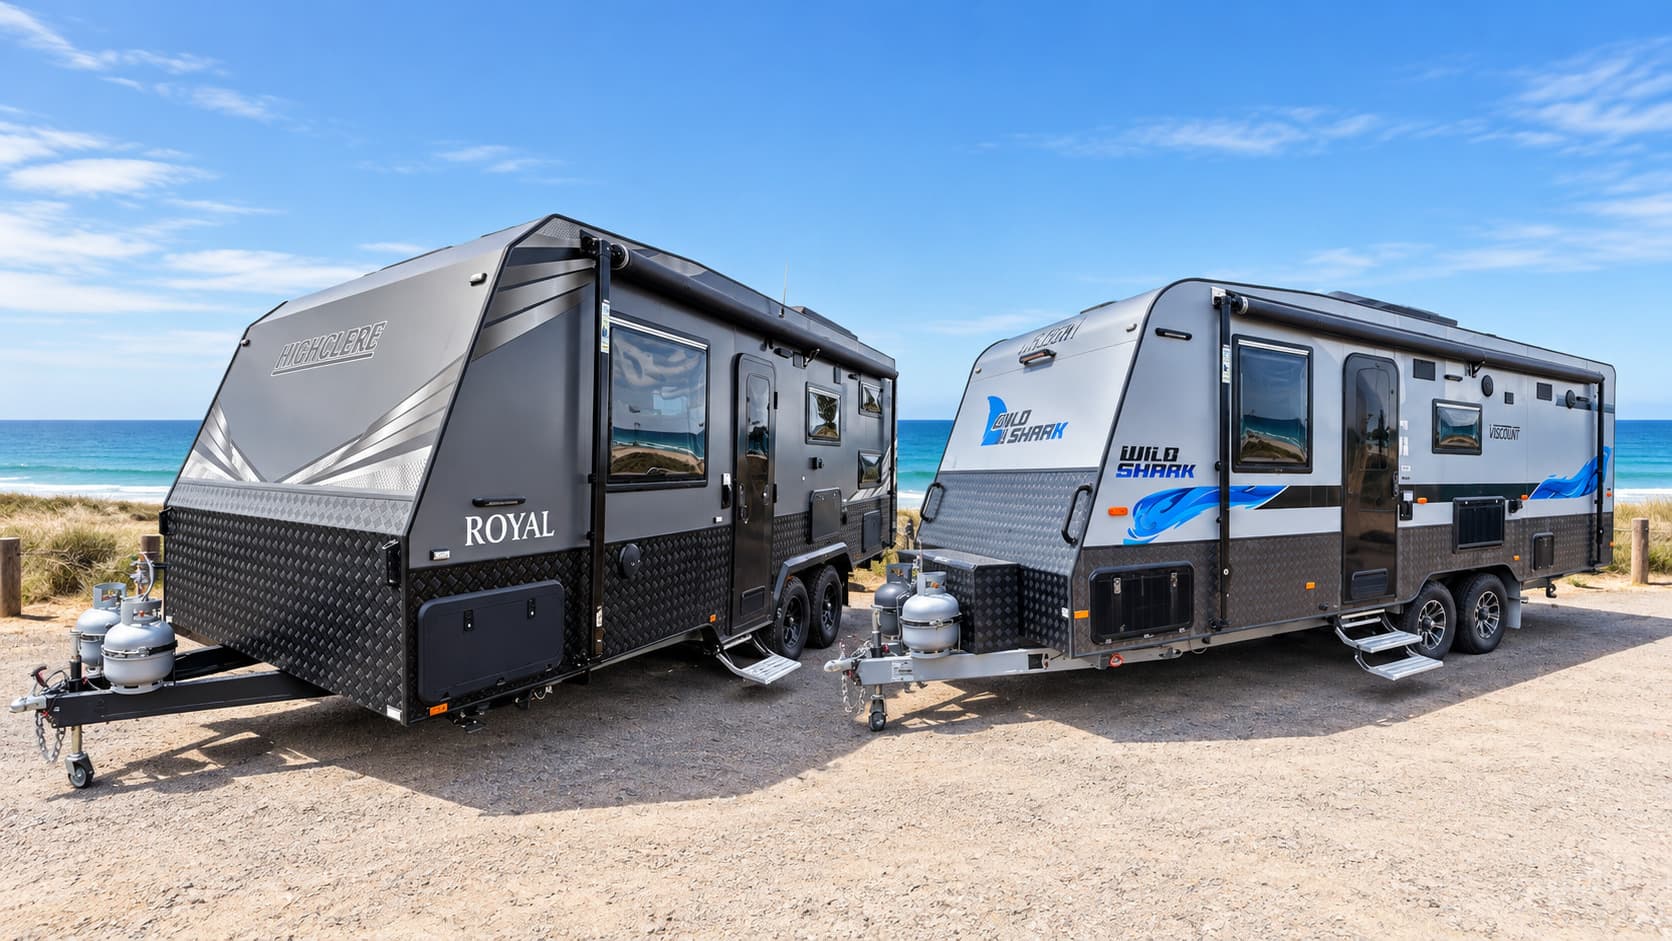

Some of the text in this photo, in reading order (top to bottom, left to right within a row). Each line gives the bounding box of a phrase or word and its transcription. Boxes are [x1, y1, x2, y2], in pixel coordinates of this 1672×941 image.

[275, 320, 388, 370] HIGHCLERE
[1006, 421, 1069, 444] SHARK
[1120, 445, 1180, 462] WILD
[1115, 462, 1196, 479] SHARK
[465, 510, 555, 546] ROYAL
